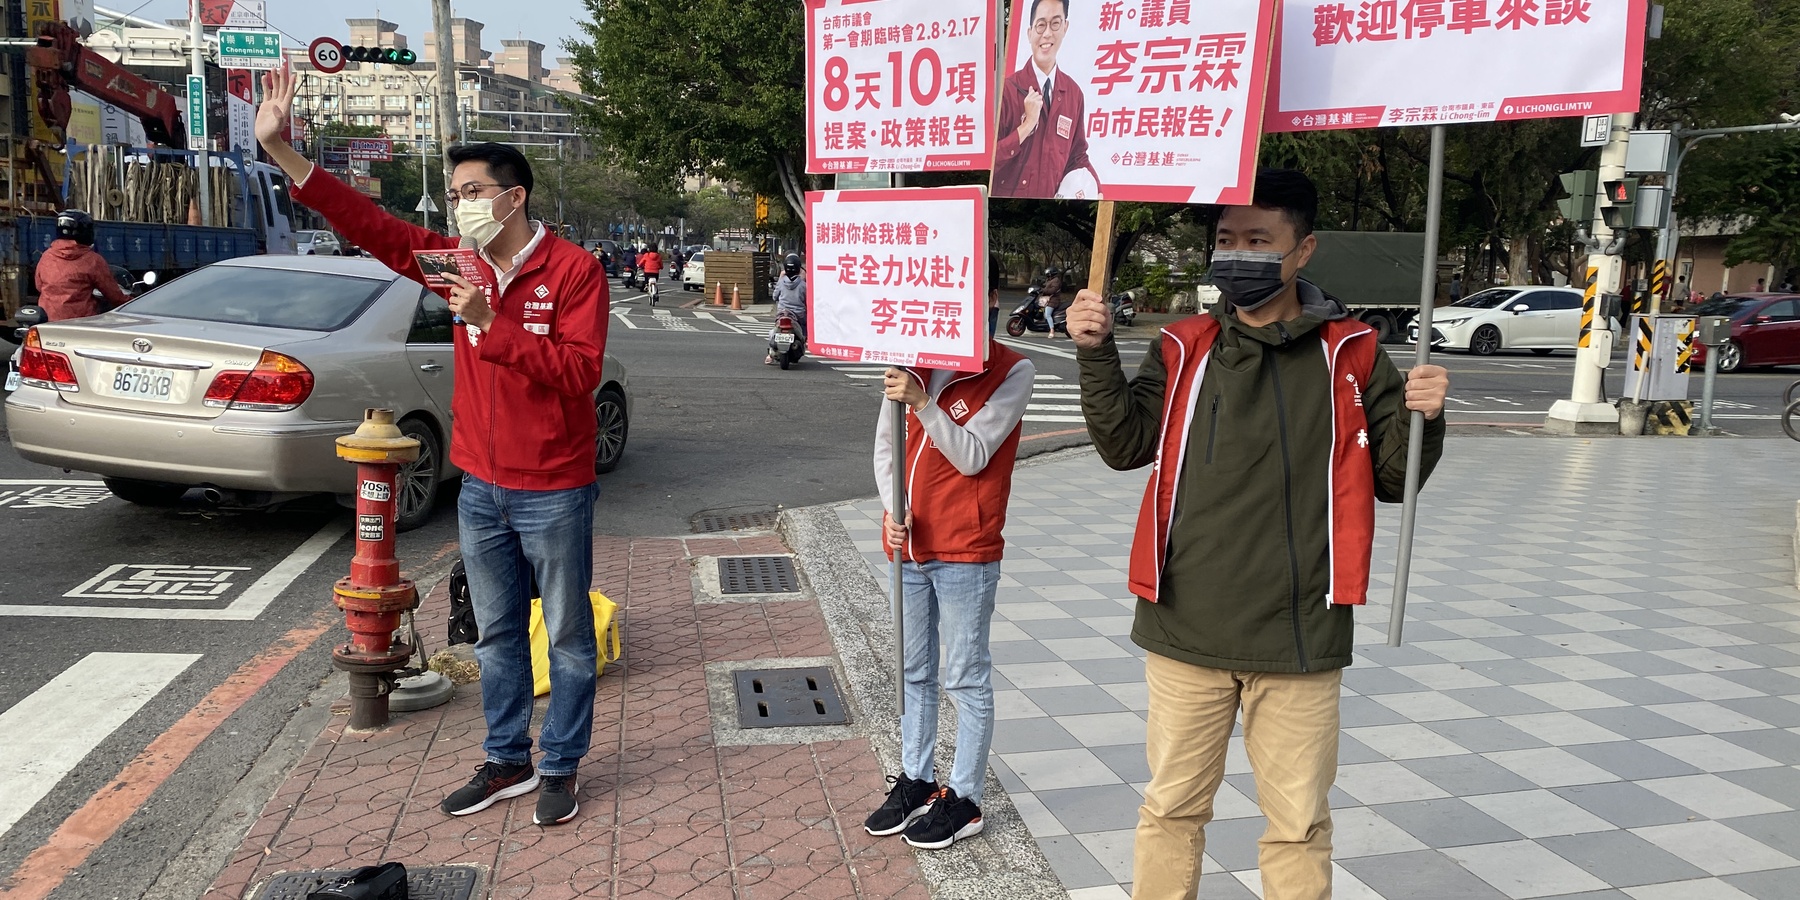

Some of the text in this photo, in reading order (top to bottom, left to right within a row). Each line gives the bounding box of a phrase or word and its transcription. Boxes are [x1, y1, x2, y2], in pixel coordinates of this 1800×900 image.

[823, 11, 872, 31] 台南市議會
[1312, 0, 1592, 47] 歡迎停車來談
[226, 35, 274, 46] 崇明路
[226, 47, 264, 55] Chongming
[318, 50, 338, 61] 60
[1090, 32, 1247, 96] 李宗霖
[823, 47, 977, 112] 8天10項
[193, 90, 201, 135] 中華東路三段
[1388, 106, 1438, 123] 李宗霖
[1516, 102, 1592, 114] LICHONGLIMTW
[1086, 105, 1233, 138] 向市民報告！
[1302, 112, 1353, 127] 台灣基進
[827, 160, 853, 171] 台灣基進
[869, 158, 896, 171] 李宗霖
[1121, 151, 1175, 167] 台灣基進
[816, 222, 938, 245] 謝謝你給我機會，
[817, 253, 970, 289] 一定全力以赴！
[871, 298, 962, 339] 李宗霖
[864, 350, 888, 361] 李宗霖
[62, 564, 252, 600] 區
